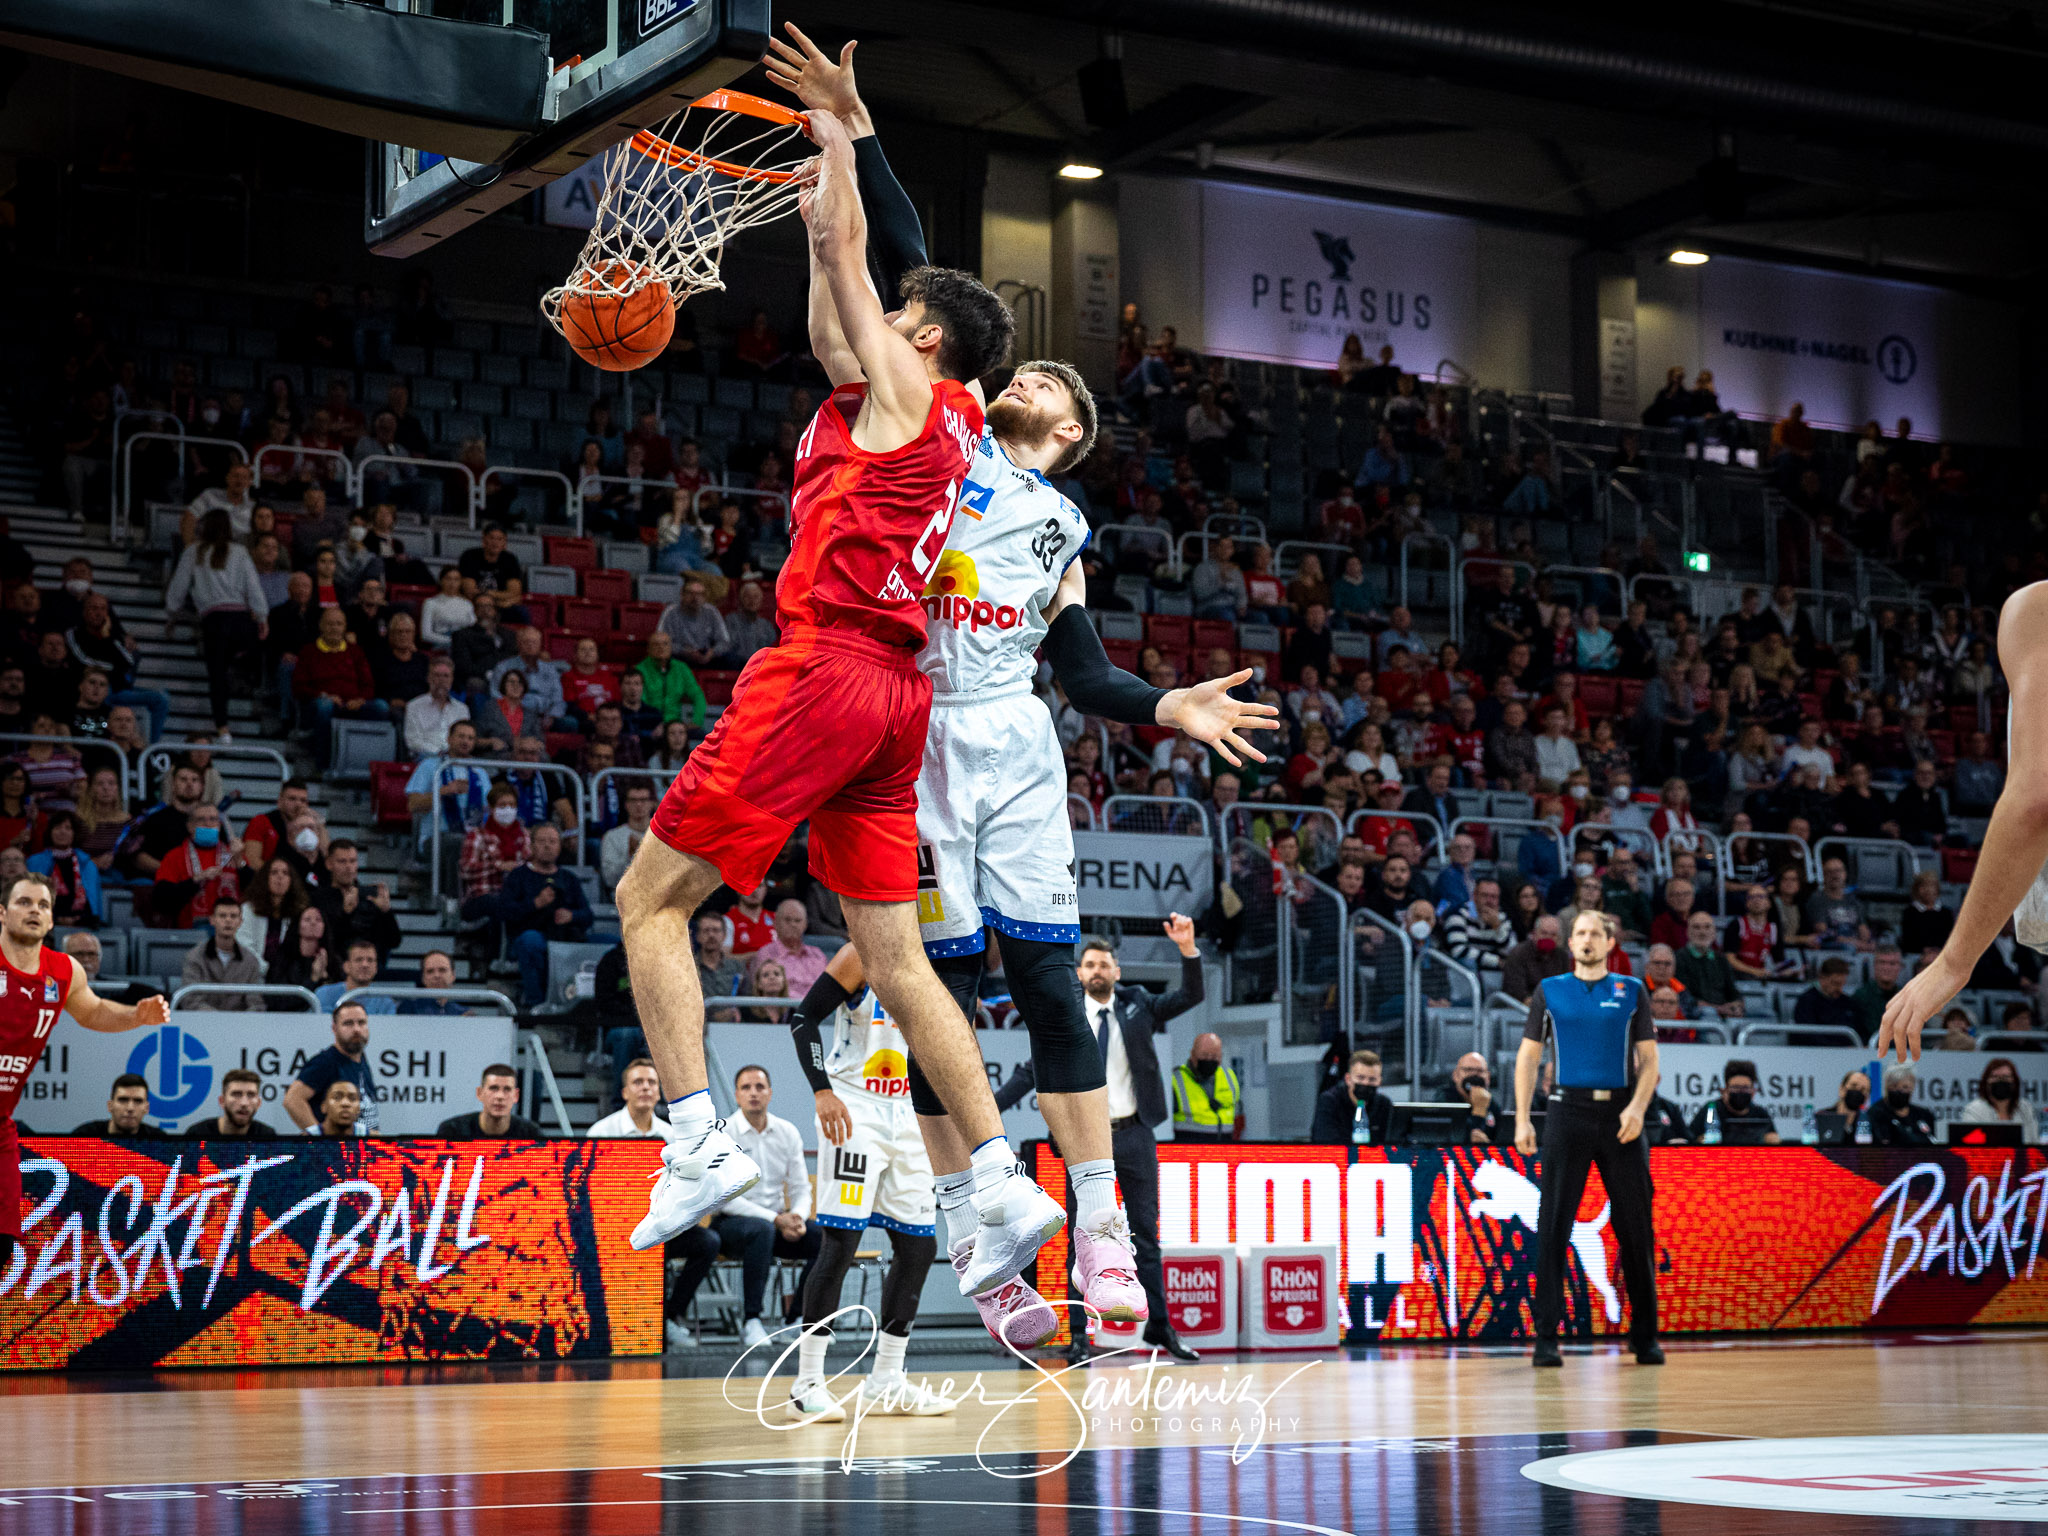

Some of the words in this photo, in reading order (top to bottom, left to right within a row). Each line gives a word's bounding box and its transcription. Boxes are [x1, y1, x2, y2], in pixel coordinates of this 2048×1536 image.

[1253, 273, 1431, 330] PEGASUS
[1031, 517, 1077, 573] 33
[1080, 858, 1193, 893] RENA
[33, 1008, 55, 1038] 17
[250, 1156, 490, 1310] BALL
[1167, 1290, 1217, 1304] SPRUDEL
[1270, 1289, 1319, 1303] SPRUDEL
